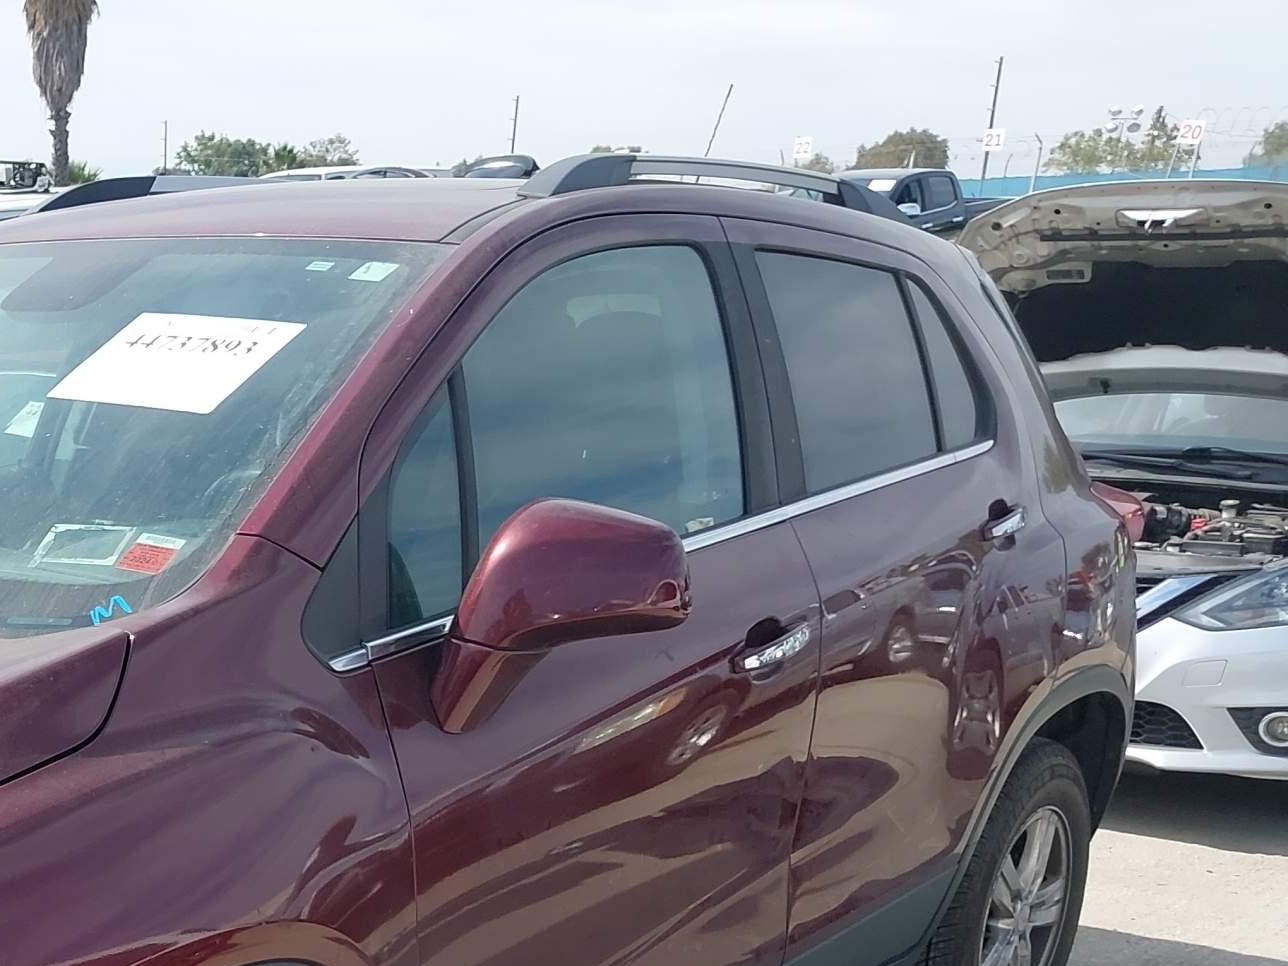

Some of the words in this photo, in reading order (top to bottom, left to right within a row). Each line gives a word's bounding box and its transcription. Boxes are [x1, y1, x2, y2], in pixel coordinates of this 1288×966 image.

[1180, 124, 1202, 139] 20
[984, 133, 1001, 147] 21
[795, 142, 810, 154] 22
[125, 333, 259, 356] 44737893
